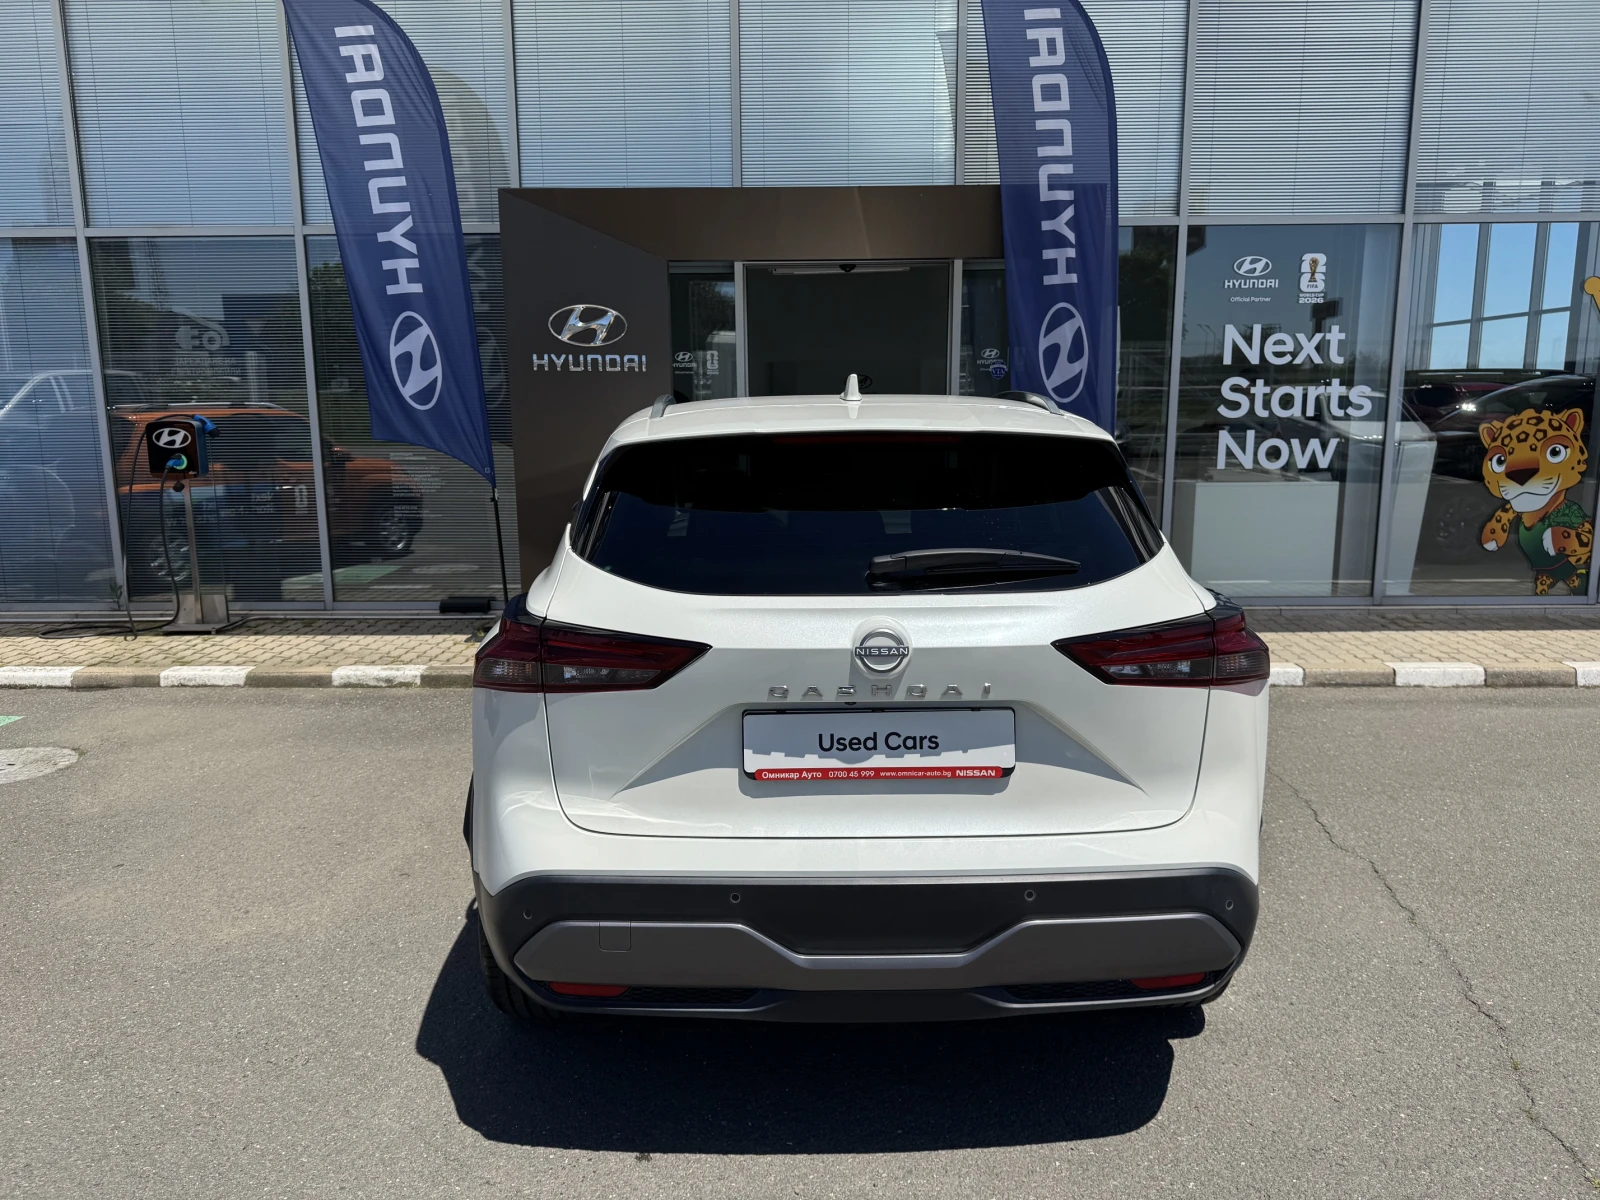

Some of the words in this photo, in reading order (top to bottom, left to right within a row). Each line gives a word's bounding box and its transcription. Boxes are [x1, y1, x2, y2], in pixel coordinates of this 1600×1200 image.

[1023, 8, 1078, 286] HYUNDAI
[333, 24, 424, 296] HYUNDAI
[1224, 279, 1279, 288] HYUNDAI
[1223, 324, 1346, 365] Next
[532, 353, 647, 372] HYUNDAI
[1216, 376, 1373, 419] Starts
[1216, 429, 1340, 470] Now
[856, 647, 908, 655] NISSAN
[768, 683, 992, 698] QASHQAI
[818, 731, 878, 752] Used
[884, 731, 940, 751] Cars
[761, 771, 799, 779] Омникар
[801, 770, 822, 779] Ауто
[828, 770, 847, 778] 0700
[879, 769, 952, 777] www.omnicar-auto.bg
[955, 769, 996, 777] NISSAN
